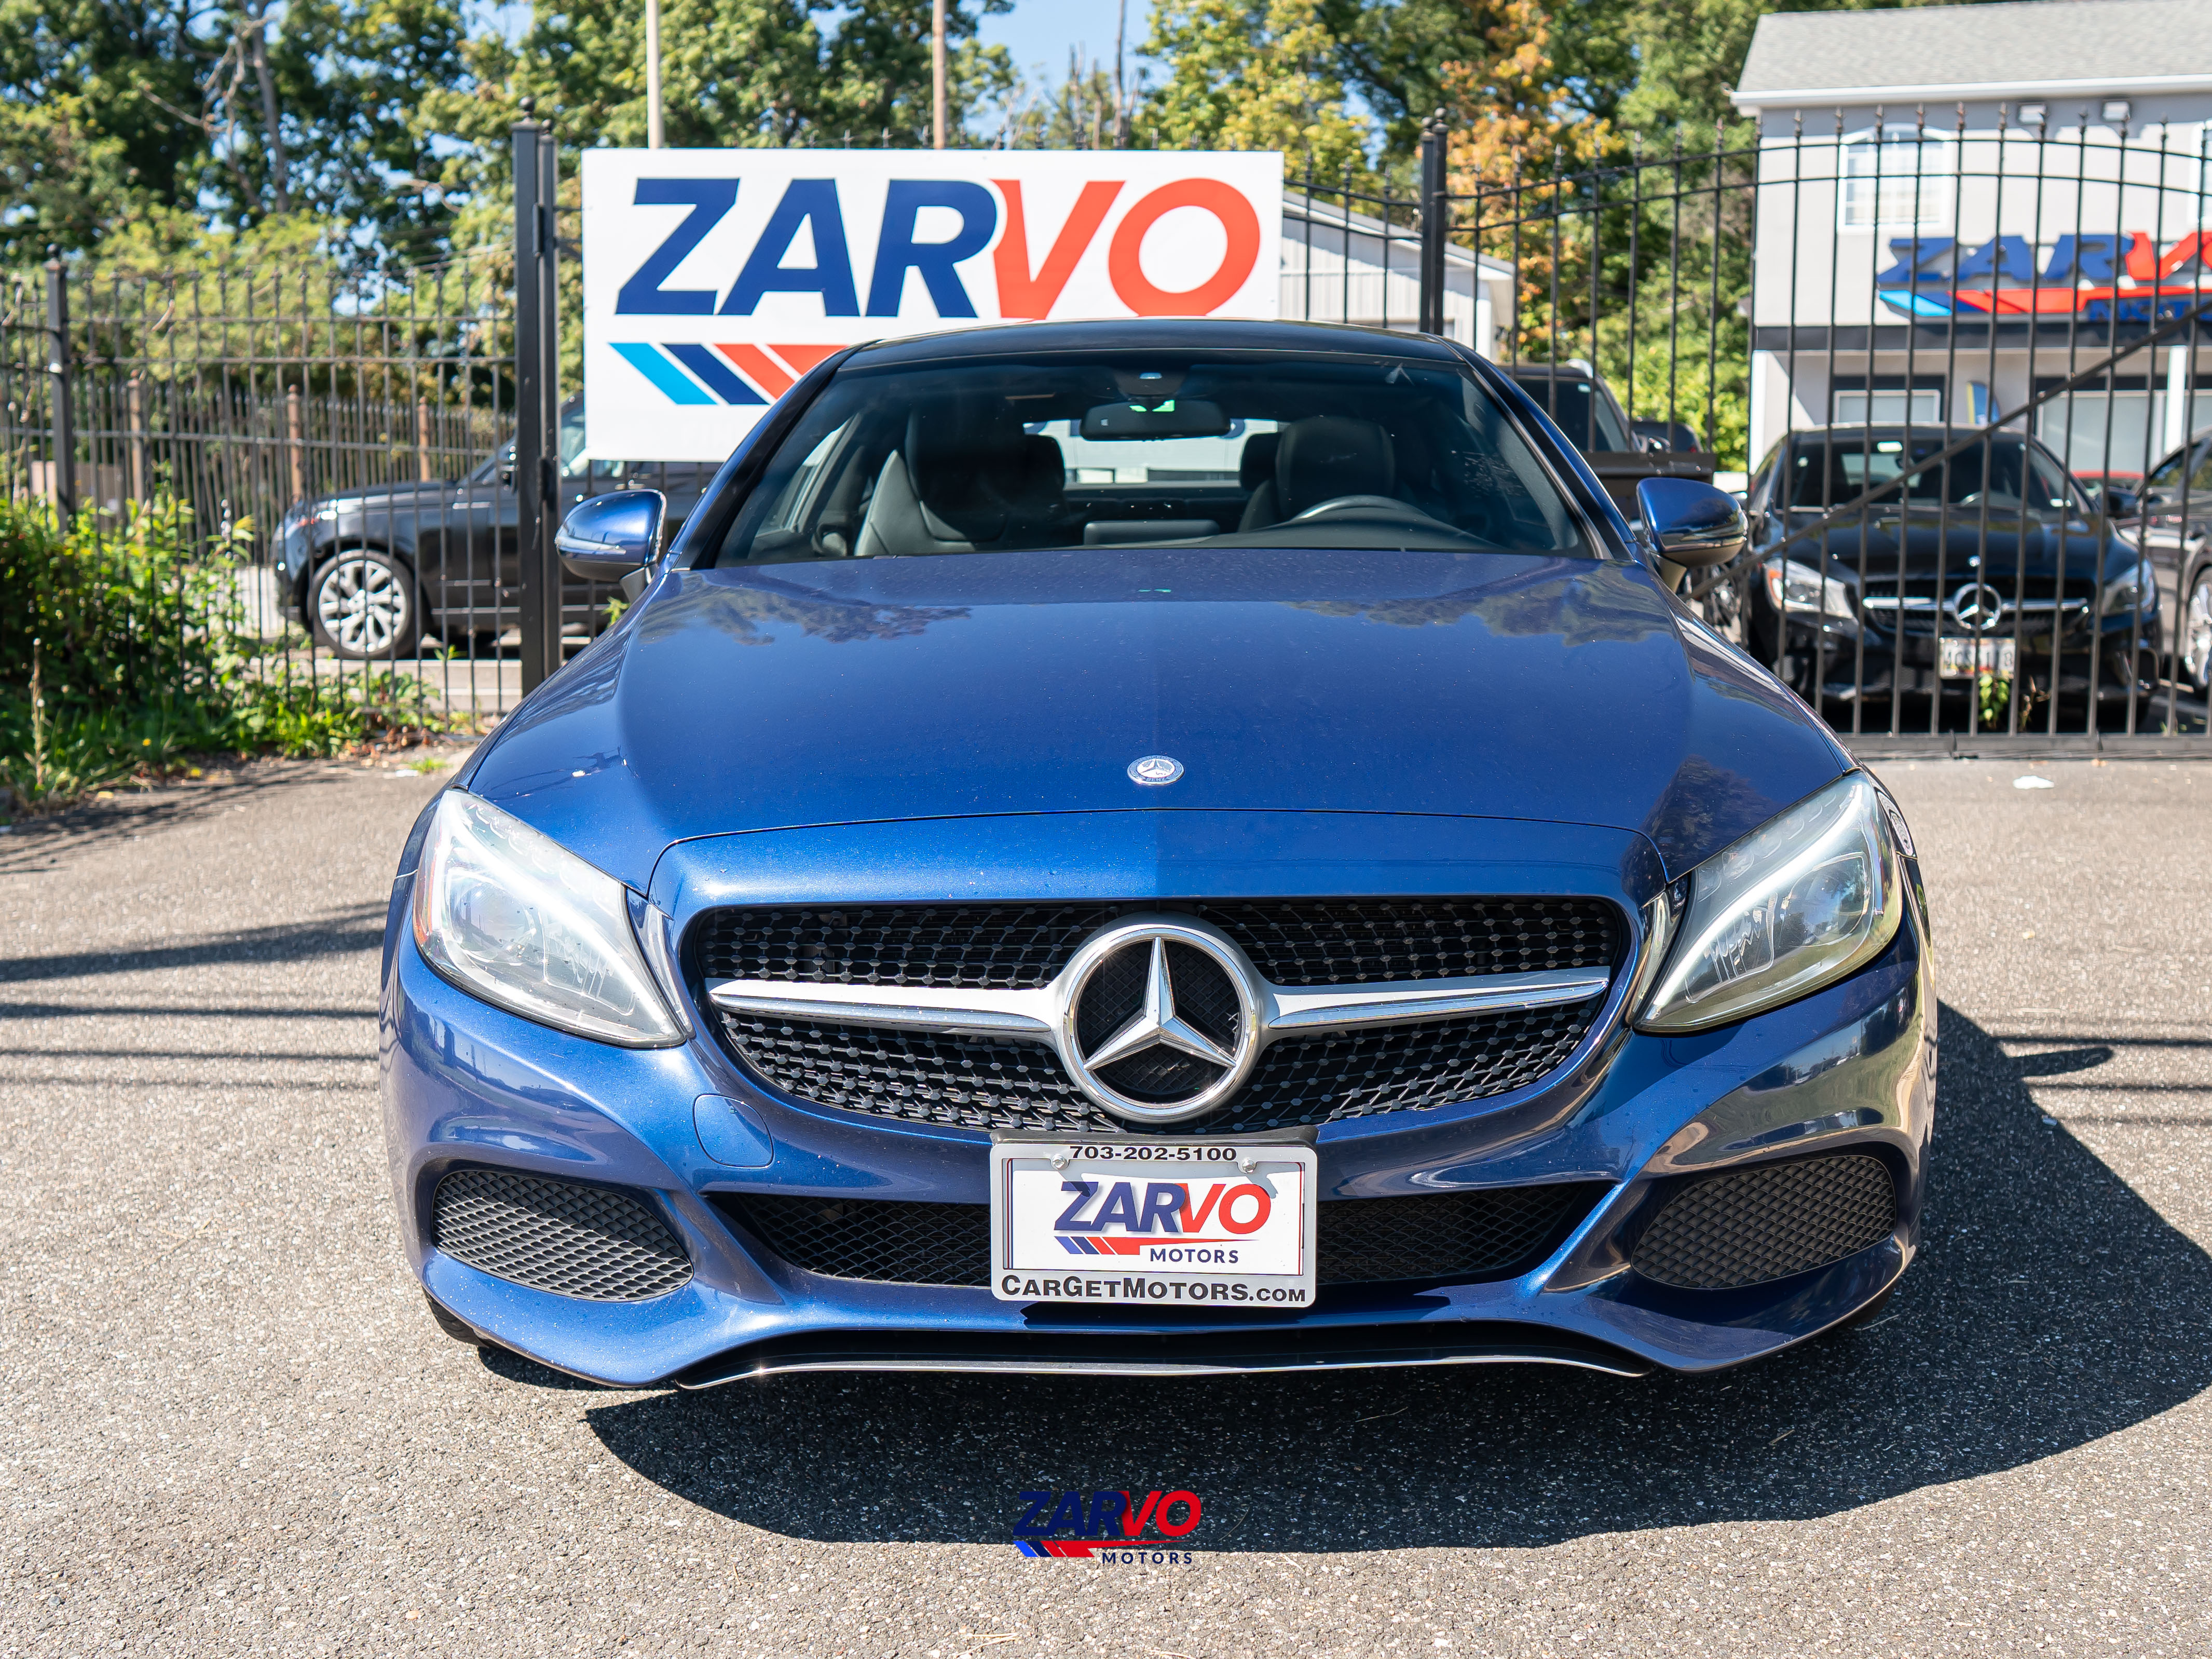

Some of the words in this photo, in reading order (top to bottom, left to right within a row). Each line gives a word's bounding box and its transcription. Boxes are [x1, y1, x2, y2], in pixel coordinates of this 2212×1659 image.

[615, 178, 1260, 319] ZARVO
[1877, 232, 2212, 282] ZARV
[1070, 1145, 1237, 1161] 703-202-5100
[1054, 1181, 1272, 1234] ZARVO
[1150, 1248, 1239, 1264] MOTORS
